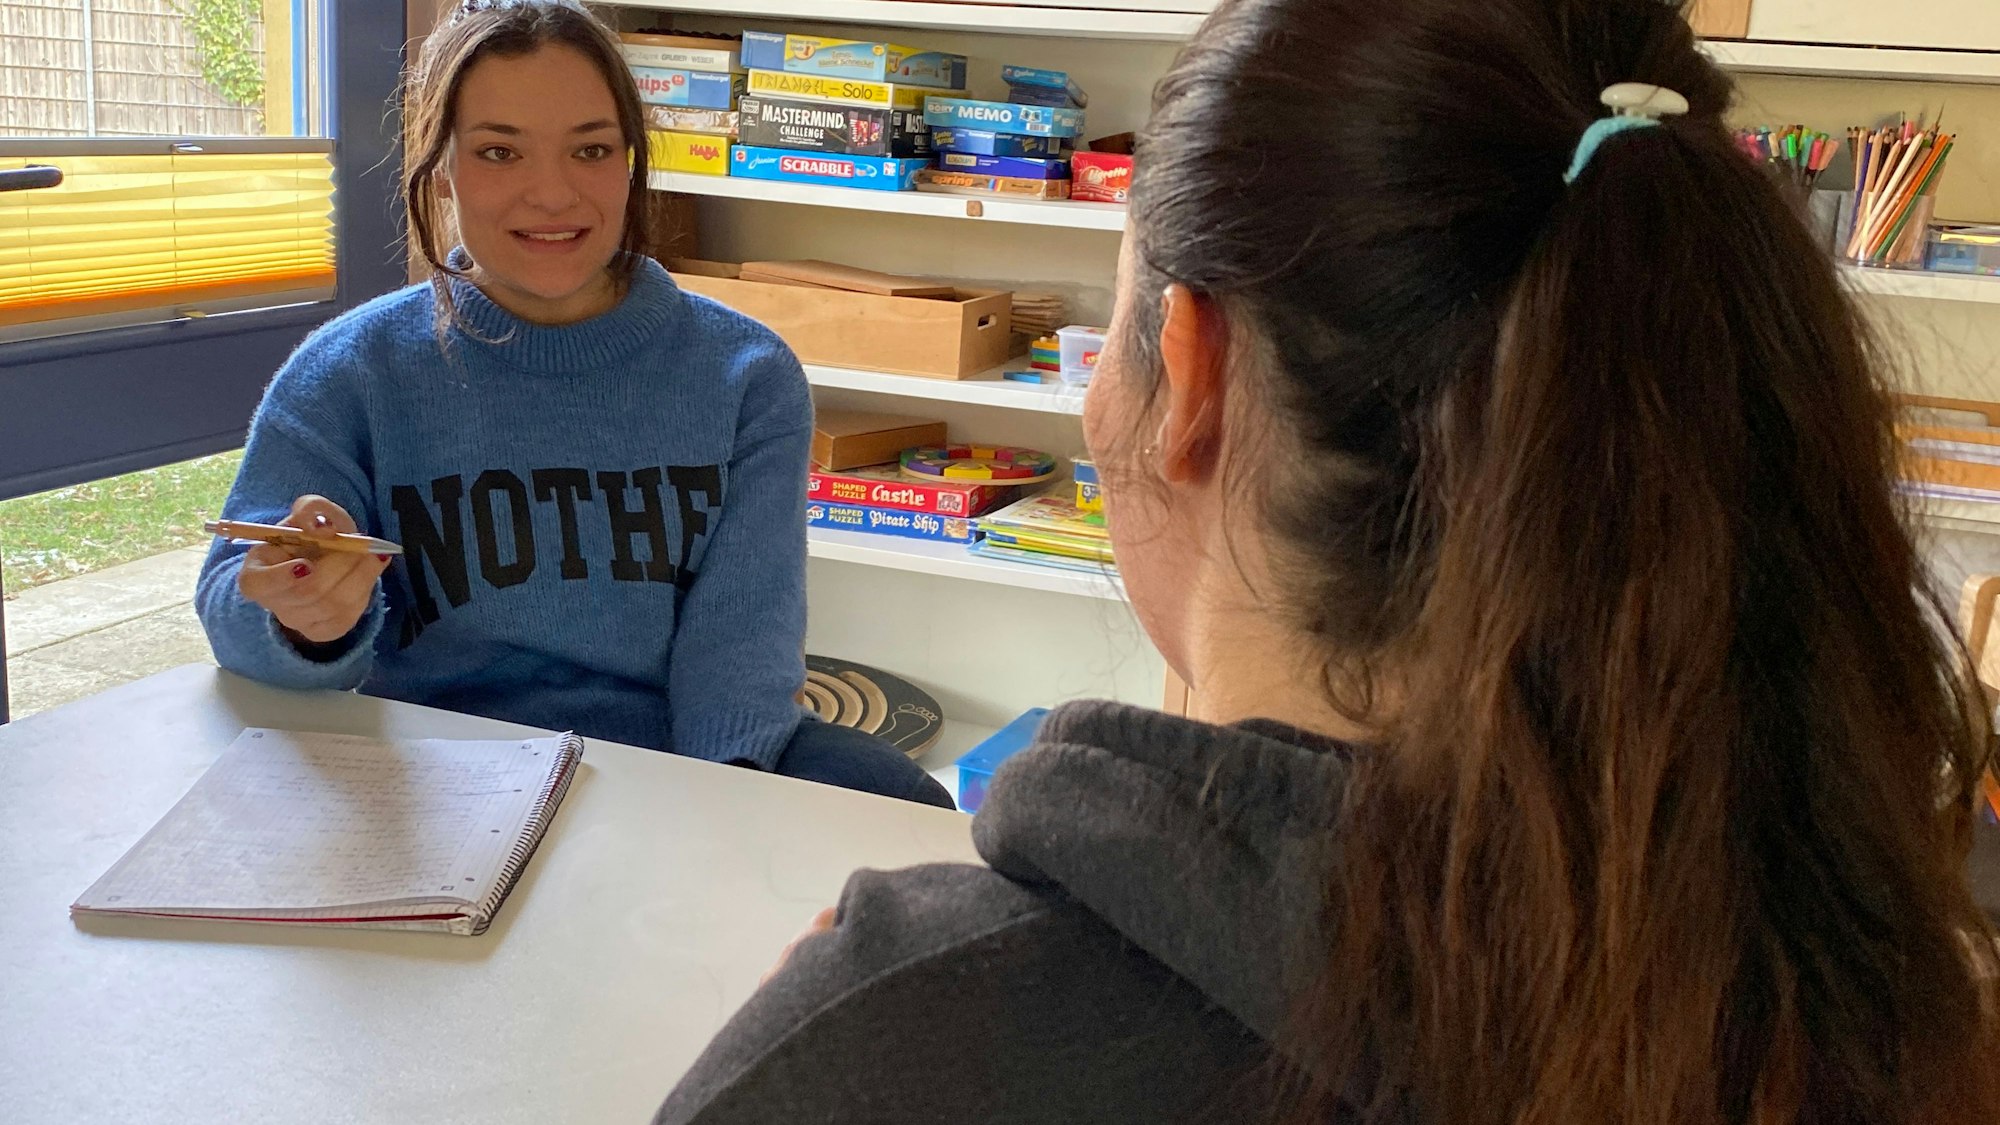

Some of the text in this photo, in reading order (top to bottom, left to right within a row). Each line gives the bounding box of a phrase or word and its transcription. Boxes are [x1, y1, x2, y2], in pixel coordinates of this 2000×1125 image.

[635, 74, 671, 95] uips
[843, 82, 873, 100] Solo
[762, 104, 845, 129] MASTERMIND
[958, 105, 1013, 123] MEMO
[780, 125, 824, 139] CHALLENGE
[689, 144, 720, 160] HABA
[748, 154, 853, 176] Junior SCRABBLE
[832, 482, 867, 493] SHAPED
[832, 490, 866, 500] PUZZLE
[871, 484, 926, 507] Castle
[829, 507, 864, 518] SHAPED
[829, 515, 863, 525] PUZZLE
[869, 510, 939, 534] Pirate Ship
